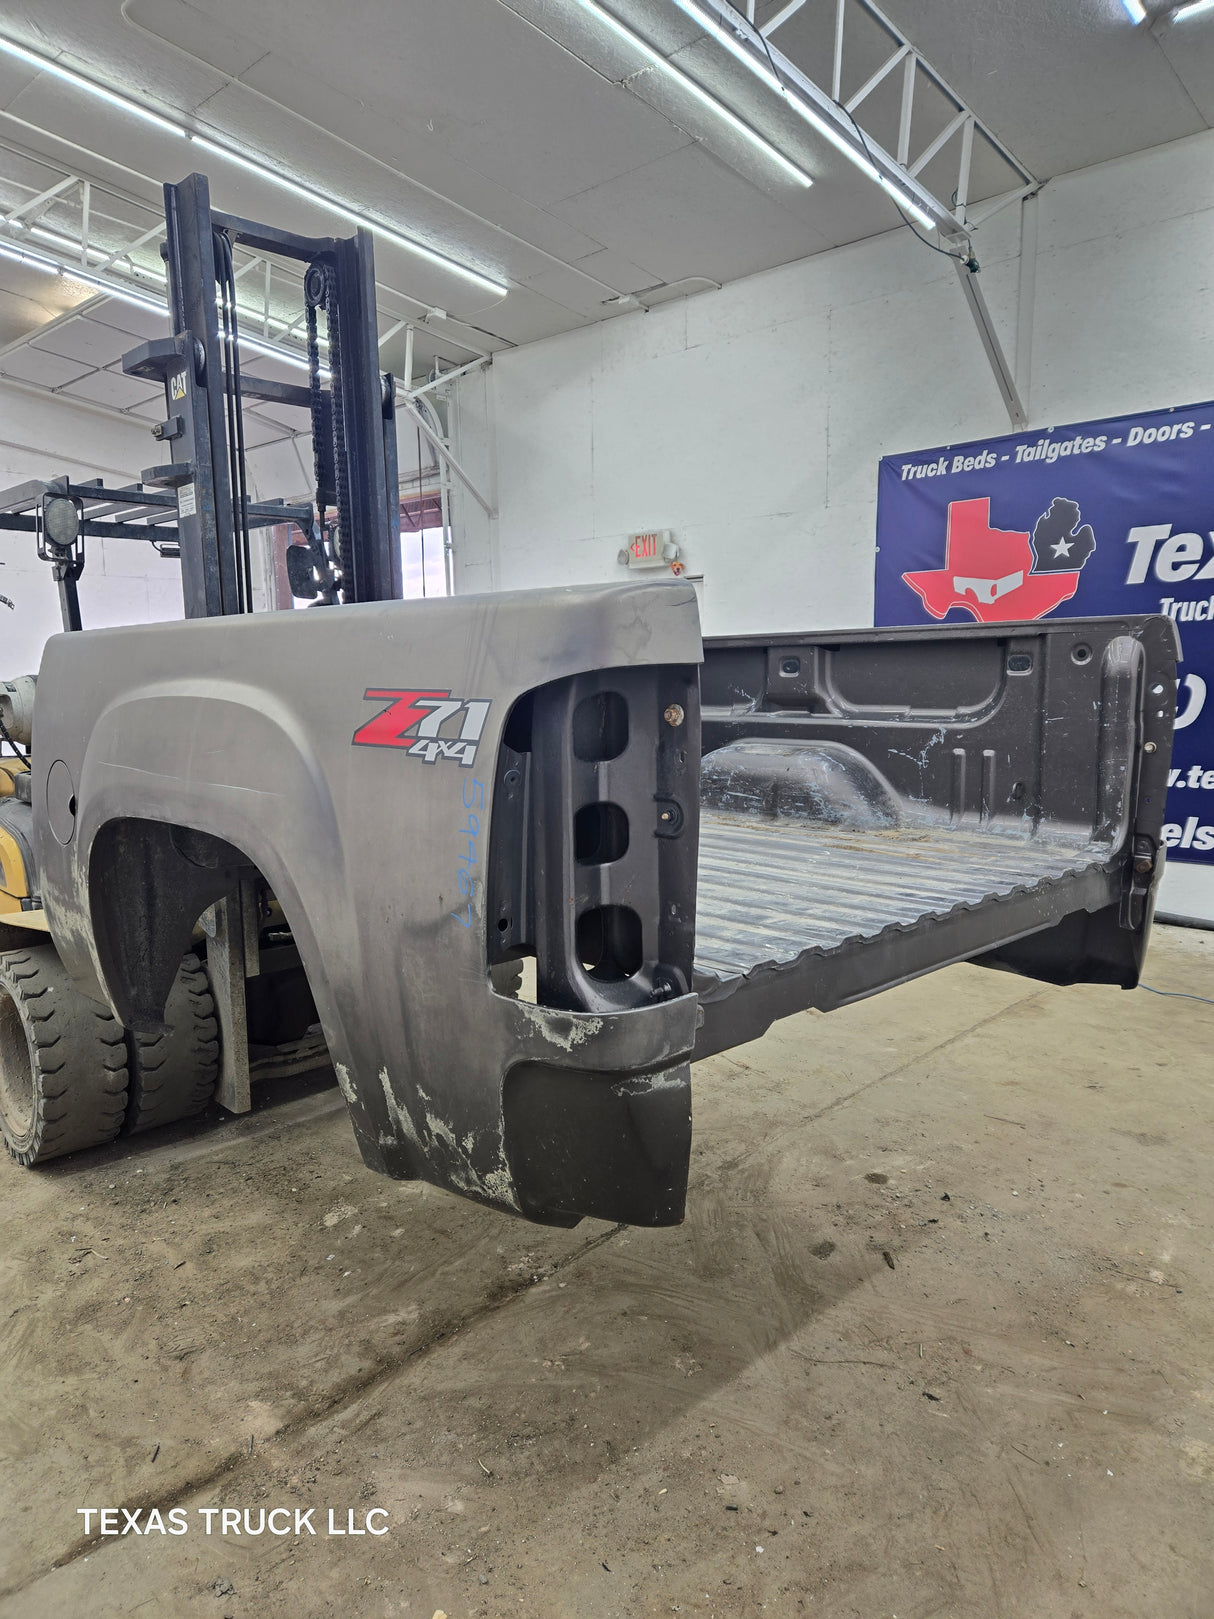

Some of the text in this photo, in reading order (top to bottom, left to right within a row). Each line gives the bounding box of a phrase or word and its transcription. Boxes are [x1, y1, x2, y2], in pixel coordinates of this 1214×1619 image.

[170, 371, 188, 400] CAT
[901, 457, 949, 481] Truck
[951, 450, 997, 474] Beds
[1015, 435, 1108, 464] Tailgates
[1126, 422, 1195, 447] Doors
[635, 533, 657, 558] EXIT
[352, 688, 493, 750] Z71
